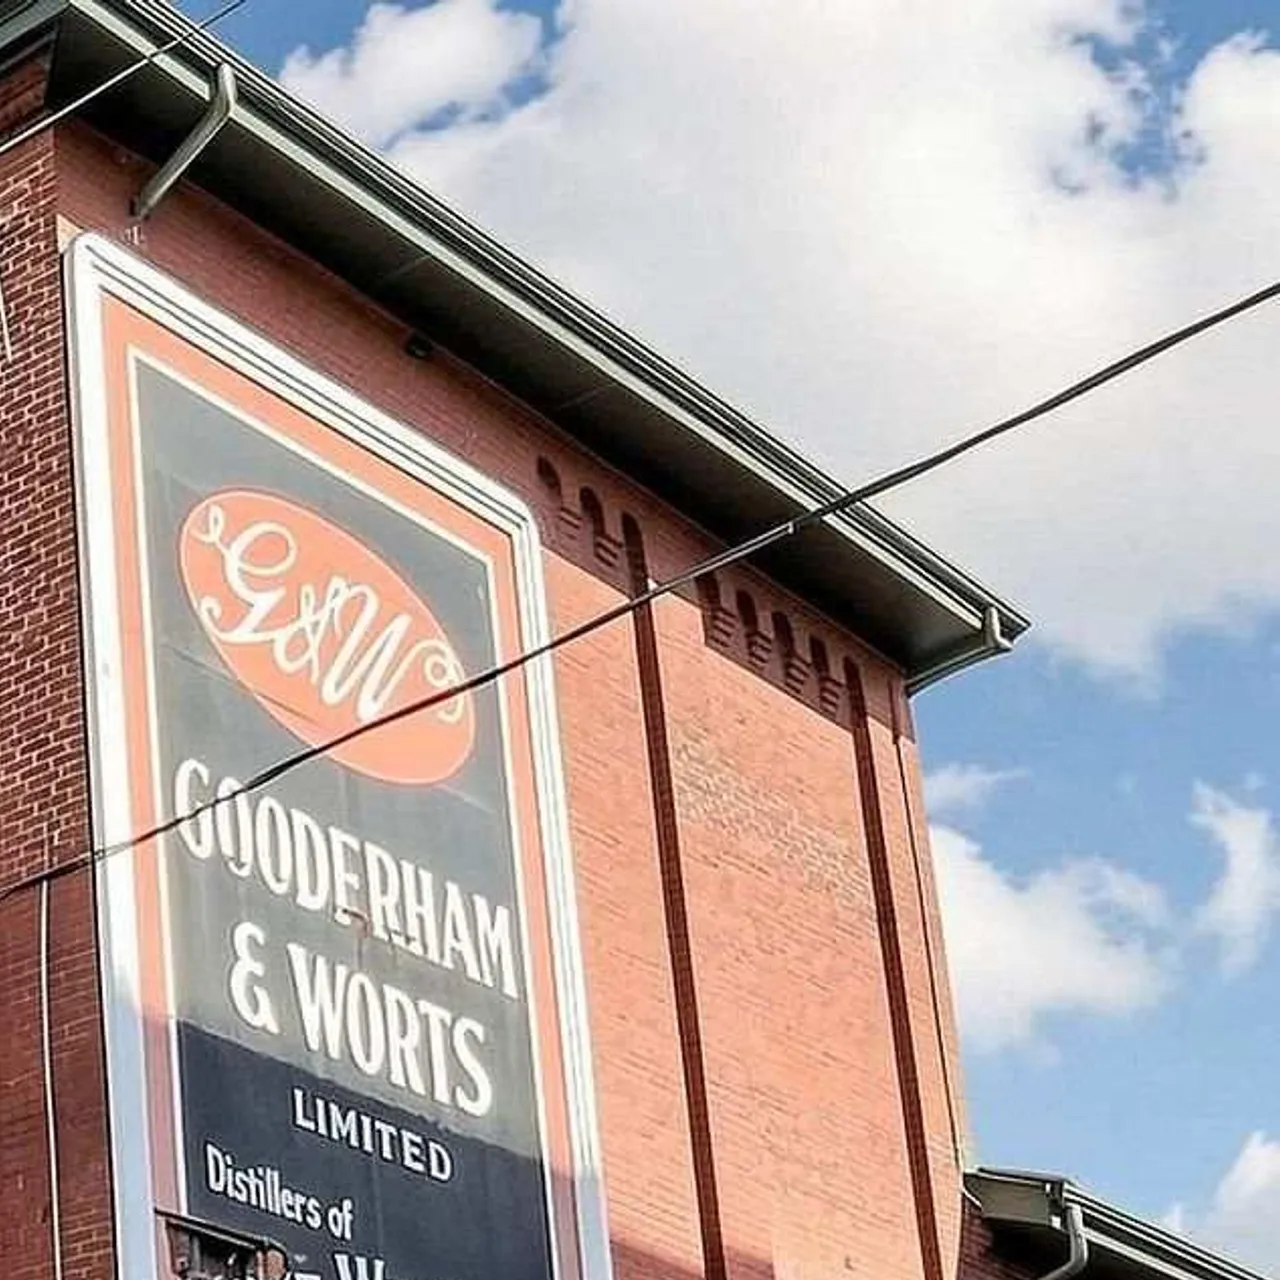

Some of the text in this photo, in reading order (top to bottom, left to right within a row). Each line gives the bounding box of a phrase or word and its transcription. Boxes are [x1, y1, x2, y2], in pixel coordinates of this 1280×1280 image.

[174, 758, 519, 999] GOODERHAM
[230, 921, 493, 1117] & WORTS
[205, 1143, 354, 1241] Distillers of
[293, 1087, 453, 1182] LIMITED
